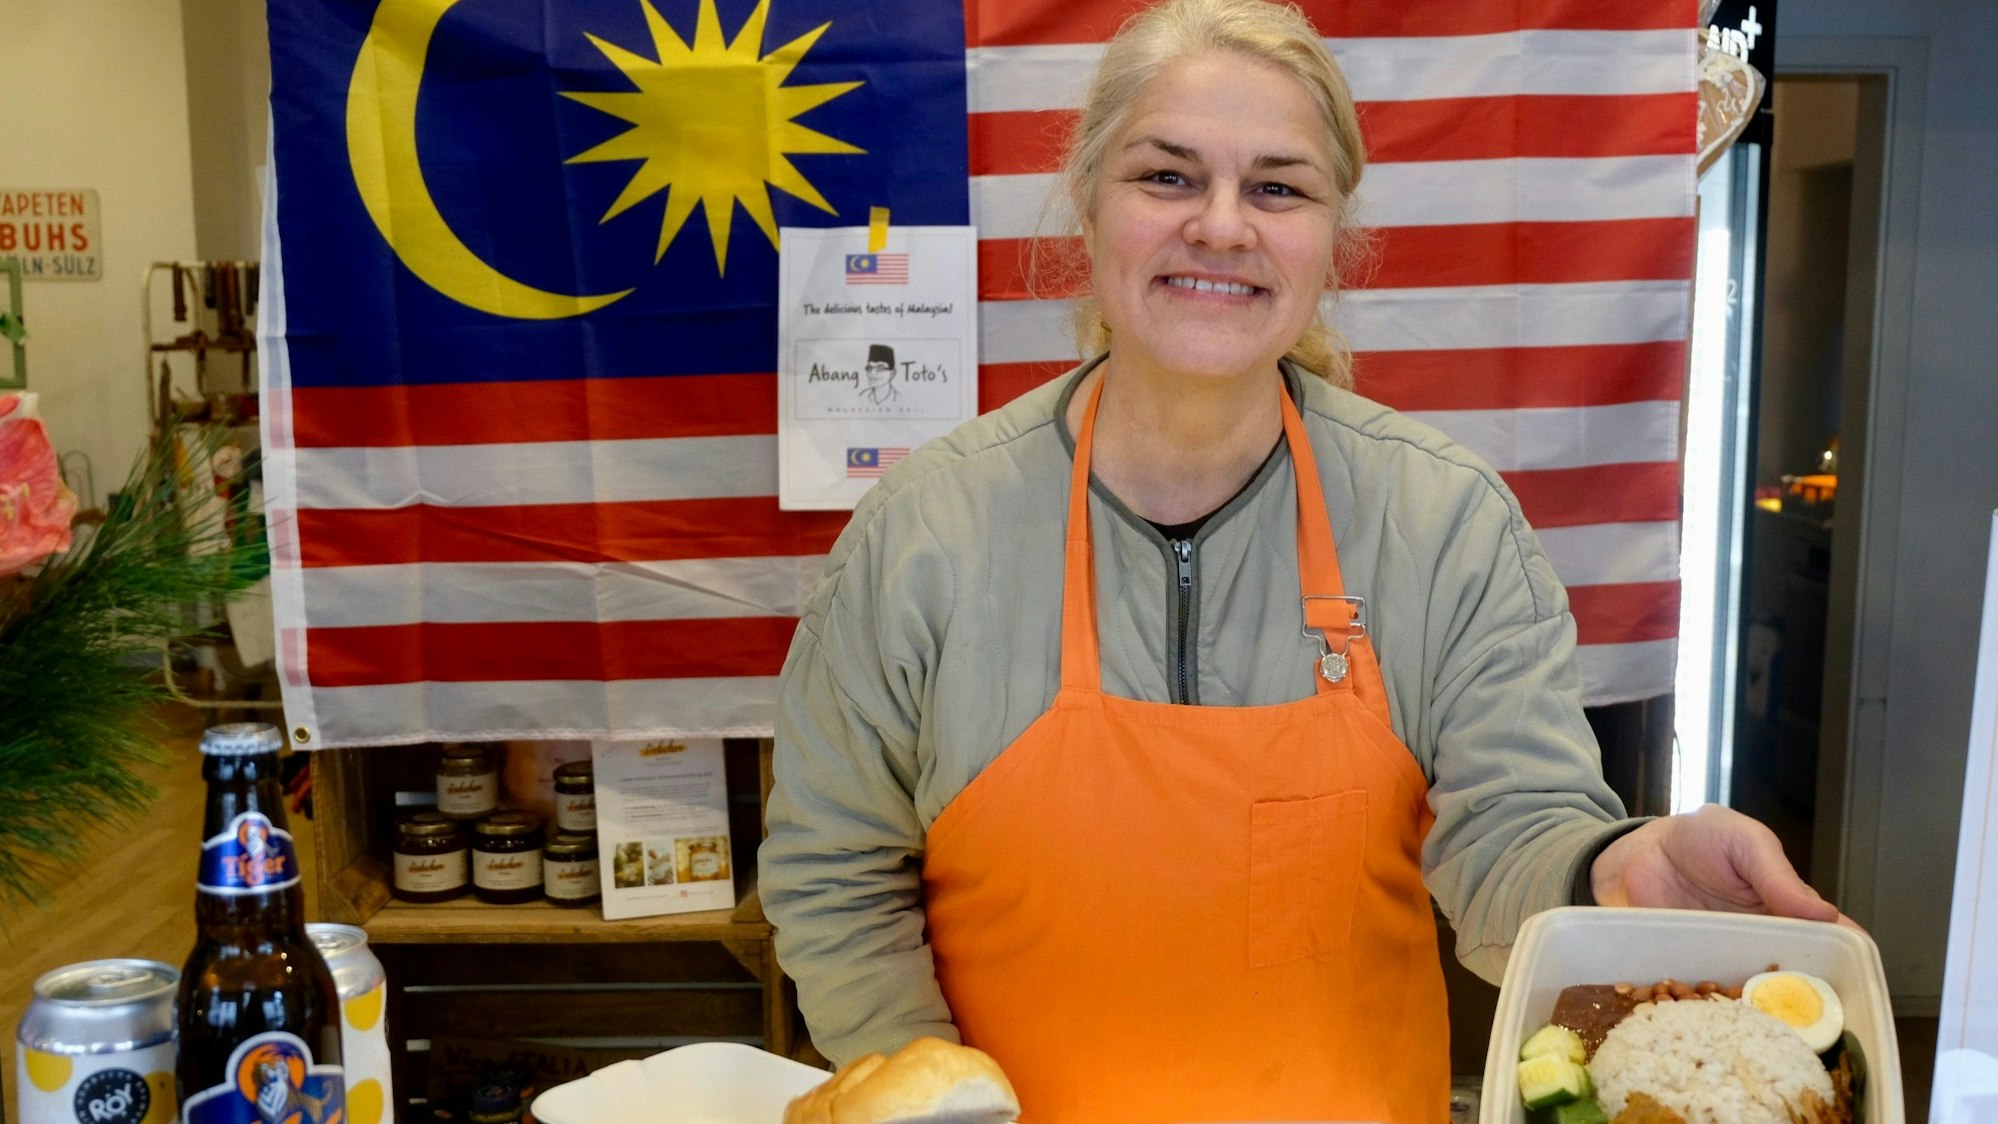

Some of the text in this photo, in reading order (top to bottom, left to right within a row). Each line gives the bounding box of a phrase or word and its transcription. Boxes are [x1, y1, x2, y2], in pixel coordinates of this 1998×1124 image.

[0, 223, 88, 252] BUHS
[803, 302, 953, 318] The delicious tastes of Malaysia!
[808, 360, 947, 389] Abang Toto's
[220, 853, 285, 887] Tiger
